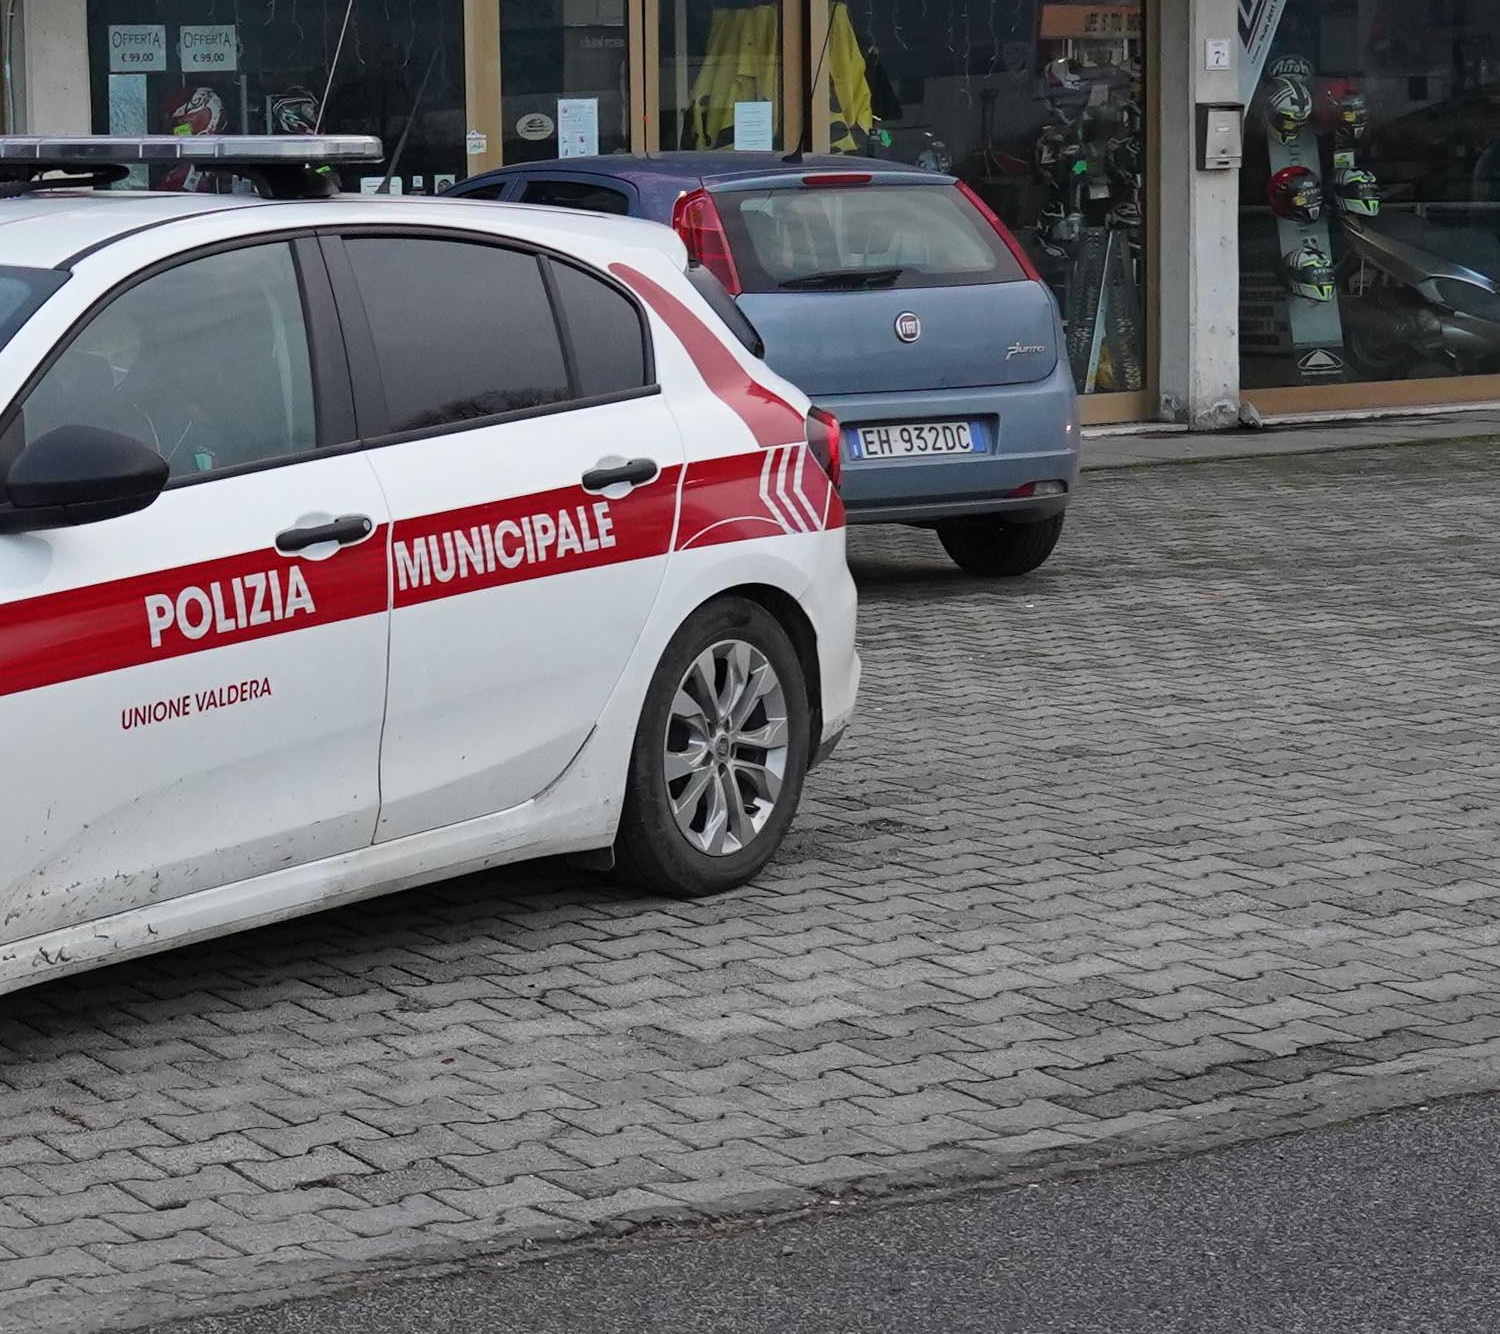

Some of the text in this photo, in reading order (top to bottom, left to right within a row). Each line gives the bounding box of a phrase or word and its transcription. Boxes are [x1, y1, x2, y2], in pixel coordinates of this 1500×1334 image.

[112, 31, 161, 49] OFFERTA
[183, 31, 231, 48] OFFERTA
[861, 424, 970, 455] EH 932DC
[144, 501, 617, 648] POLIZIA MUNICIPALE
[120, 677, 272, 731] UNIONE VALDERA
